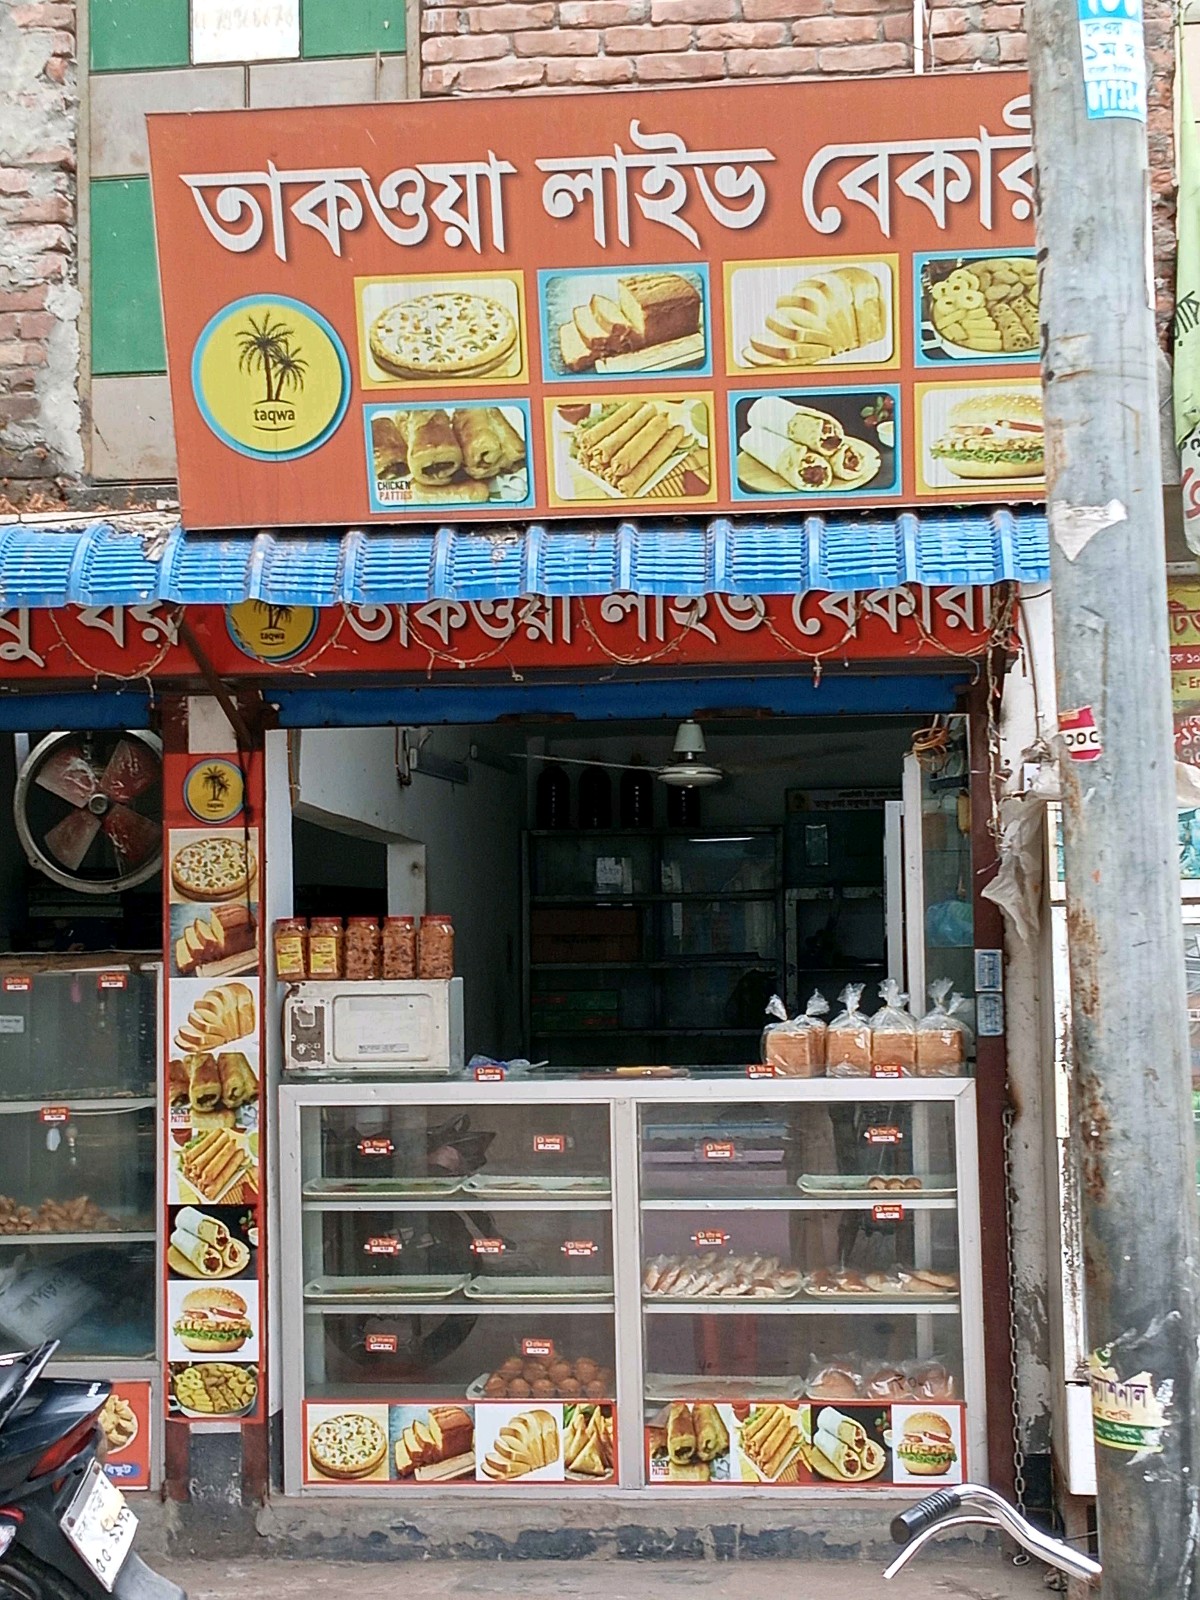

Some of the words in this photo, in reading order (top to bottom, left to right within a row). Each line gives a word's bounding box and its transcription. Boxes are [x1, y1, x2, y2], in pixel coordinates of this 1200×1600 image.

[178, 149, 518, 263] তাকওয়া
[534, 118, 777, 250] লাইভ
[253, 408, 296, 425] taqwa
[377, 480, 411, 491] CHICKEN
[379, 490, 413, 501] PATTIES
